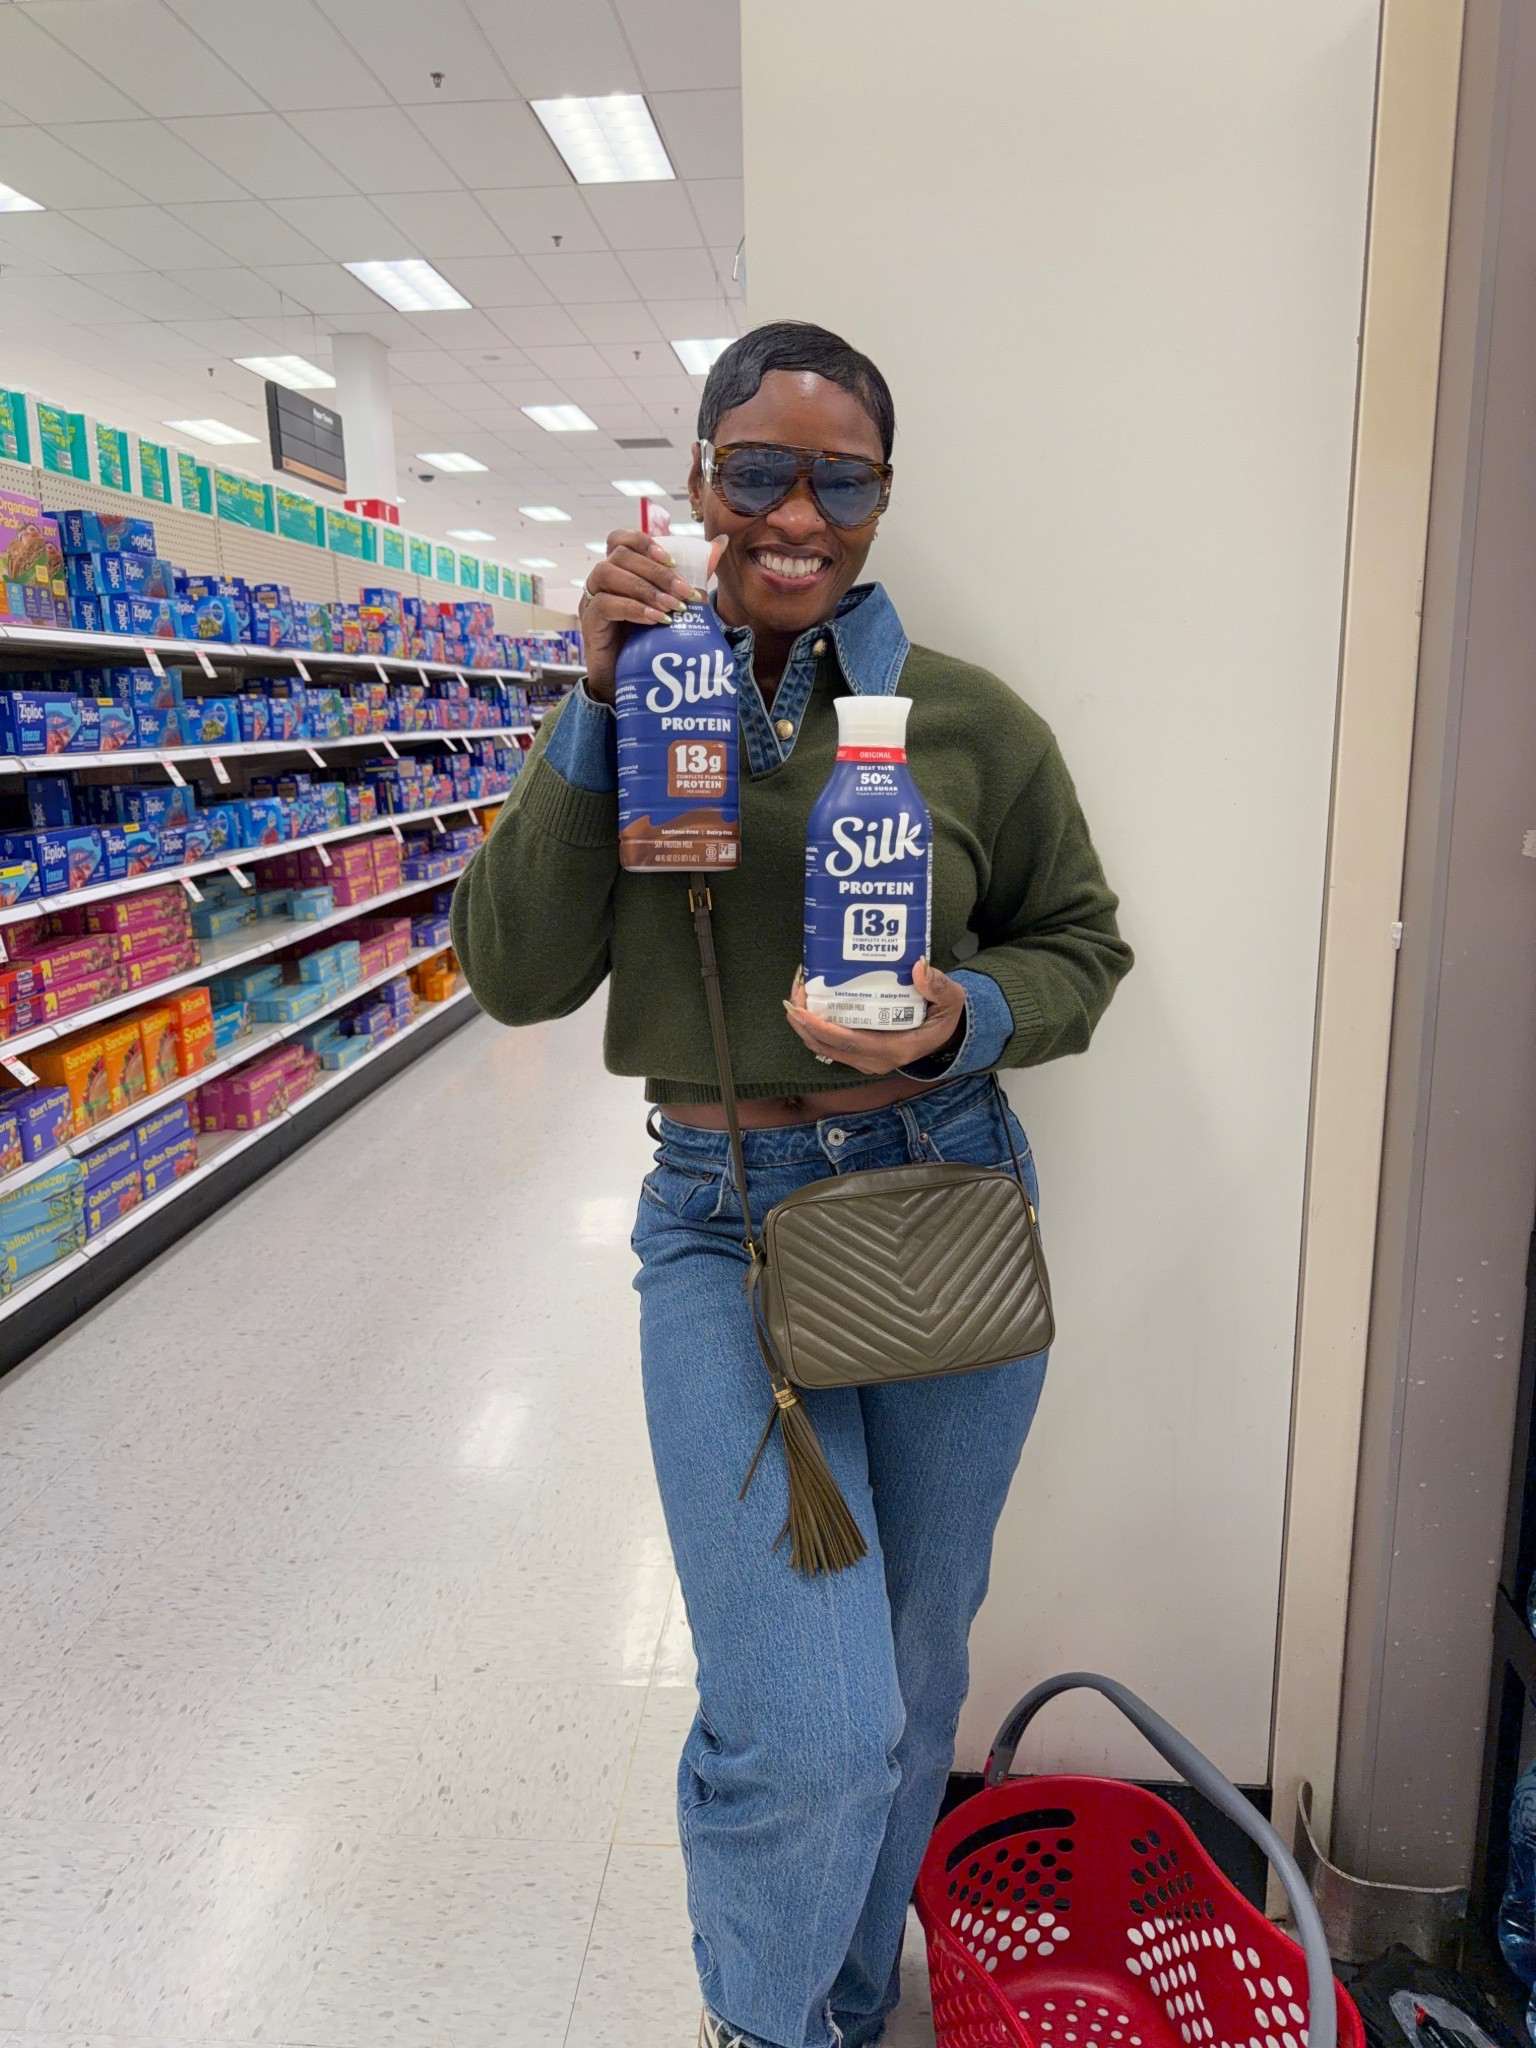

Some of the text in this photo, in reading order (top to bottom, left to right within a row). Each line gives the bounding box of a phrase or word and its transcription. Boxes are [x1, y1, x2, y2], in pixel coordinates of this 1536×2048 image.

[70, 517, 81, 547] Ziploc
[131, 534, 154, 551] Ziploc
[82, 564, 94, 592] Ziploc
[107, 561, 119, 589] Ziploc
[124, 562, 144, 580] Ziploc
[115, 603, 127, 631] Ziploc
[133, 604, 152, 621] Ziploc
[673, 612, 705, 623] 50%
[646, 650, 737, 713] Silk
[19, 704, 44, 724] Ziploc
[81, 710, 99, 725] Ziploc
[661, 717, 731, 732] PROTEIN
[675, 745, 721, 773] 13g
[860, 751, 891, 759] ORIGINAL
[676, 780, 721, 789] PROTEIN
[861, 773, 893, 785] 50%
[43, 845, 66, 864] Ziploc
[107, 839, 126, 855] Ziploc
[825, 812, 925, 877] Silk
[839, 881, 914, 895] PROTEIN
[852, 909, 899, 936] 13g
[52, 949, 91, 966] Jumbo Storage
[852, 944, 898, 952] PROTEIN
[58, 980, 100, 998] Jumbo Storage
[836, 1002, 853, 1010] PROTEIN
[855, 1003, 865, 1011] MILK
[105, 1026, 139, 1051] Sandwich
[184, 1019, 211, 1044] Snack
[66, 1043, 103, 1070] Sandwich
[29, 1092, 70, 1118] Quart Storage
[89, 1140, 130, 1168] Gallon Storage
[144, 1139, 190, 1171] Gallon Storage
[23, 1173, 66, 1196] Freezer
[89, 1171, 136, 1208] Gallon Storage
